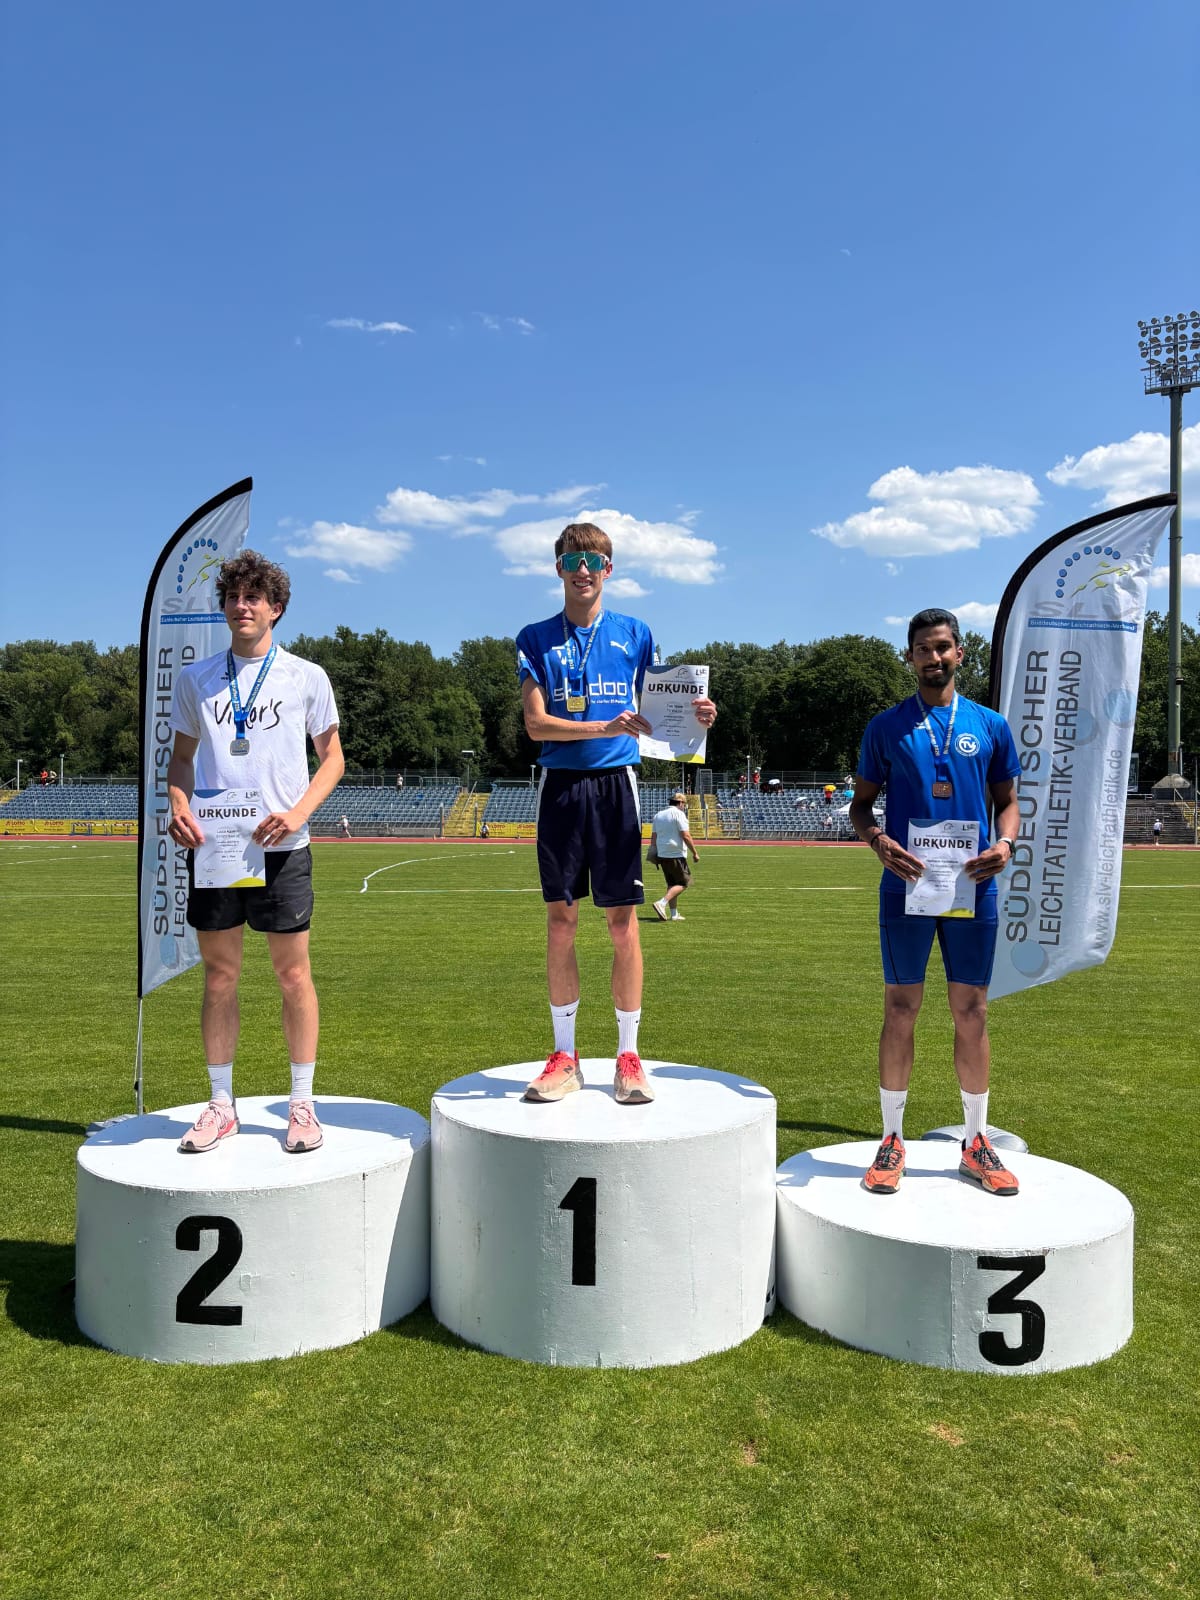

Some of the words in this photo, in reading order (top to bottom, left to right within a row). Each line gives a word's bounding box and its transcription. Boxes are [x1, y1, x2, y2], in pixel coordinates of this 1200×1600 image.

[214, 698, 283, 731] Vior's
[647, 683, 705, 695] URKUNDE
[198, 808, 257, 819] URKUNDE
[913, 837, 973, 849] URKUNDE
[1004, 650, 1049, 942] SÜDDEUTSCHER
[1039, 650, 1082, 945] LEICHTATHLETIK-VERBAND
[1095, 749, 1122, 949] www.slv-leichtathletik.de
[176, 1216, 243, 1326] 2
[558, 1177, 597, 1286] 1
[977, 1256, 1046, 1366] 3
